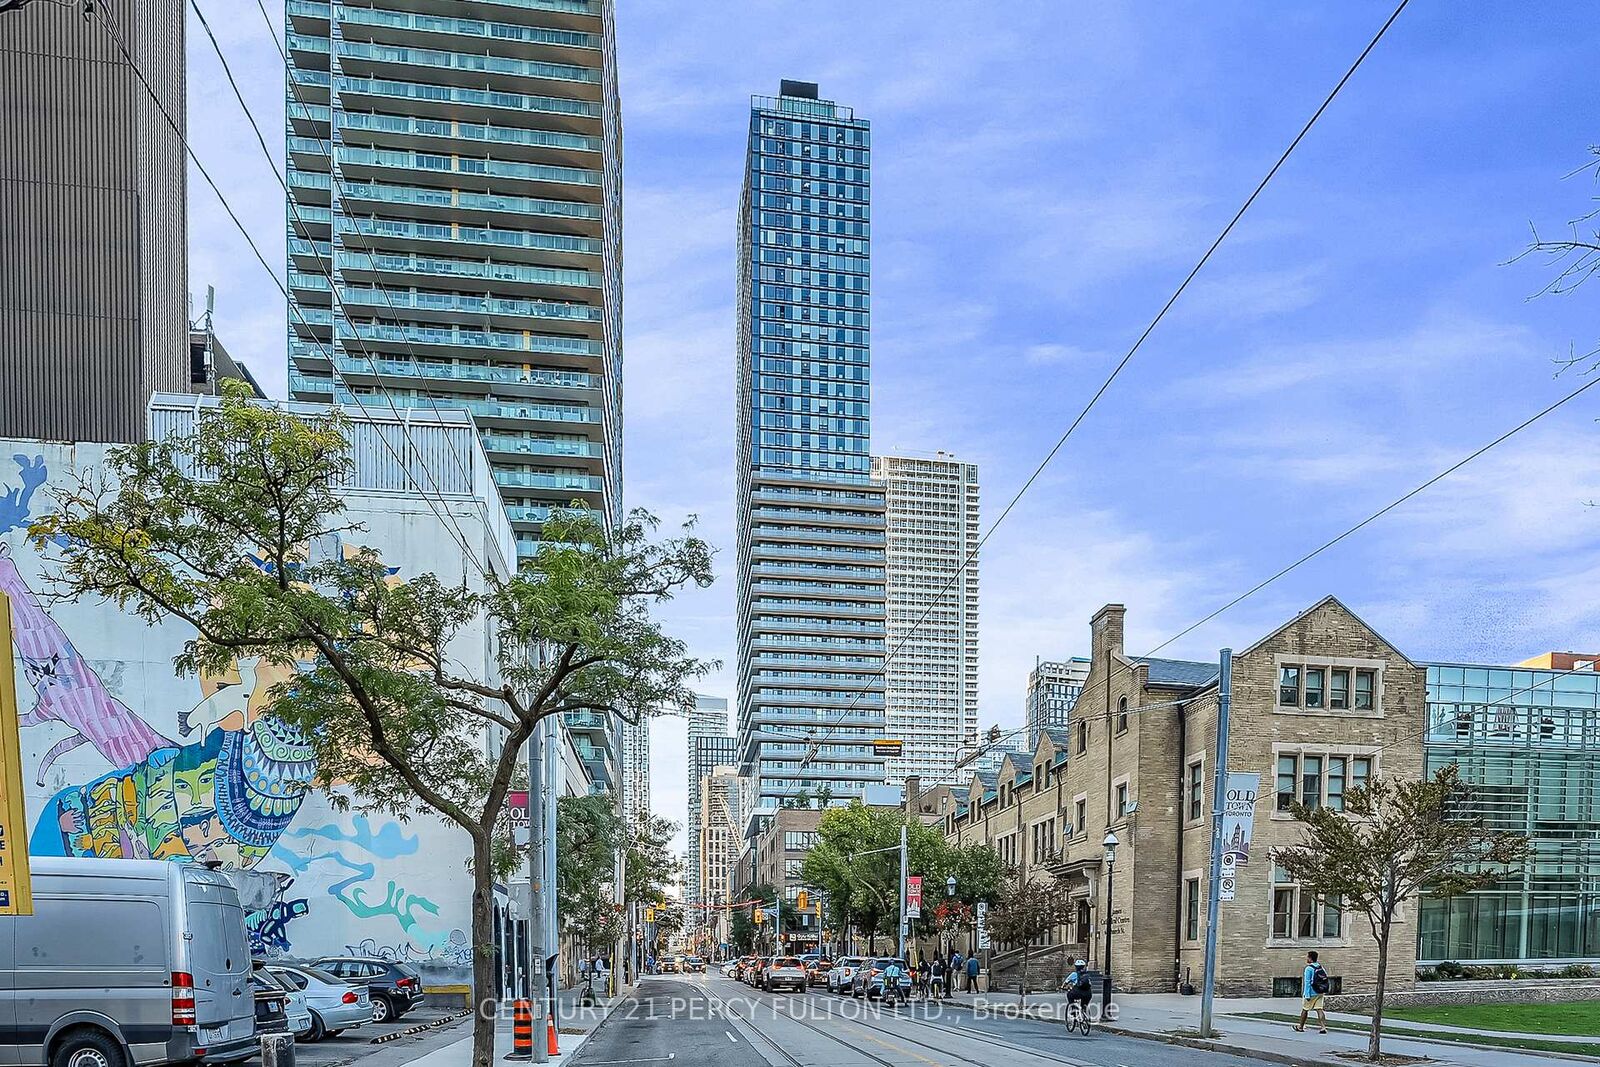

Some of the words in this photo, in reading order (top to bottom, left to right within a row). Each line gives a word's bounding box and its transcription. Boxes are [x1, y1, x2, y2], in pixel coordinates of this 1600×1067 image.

[1227, 790, 1256, 802] OLD
[1226, 801, 1253, 810] TOWN
[510, 807, 530, 820] OL
